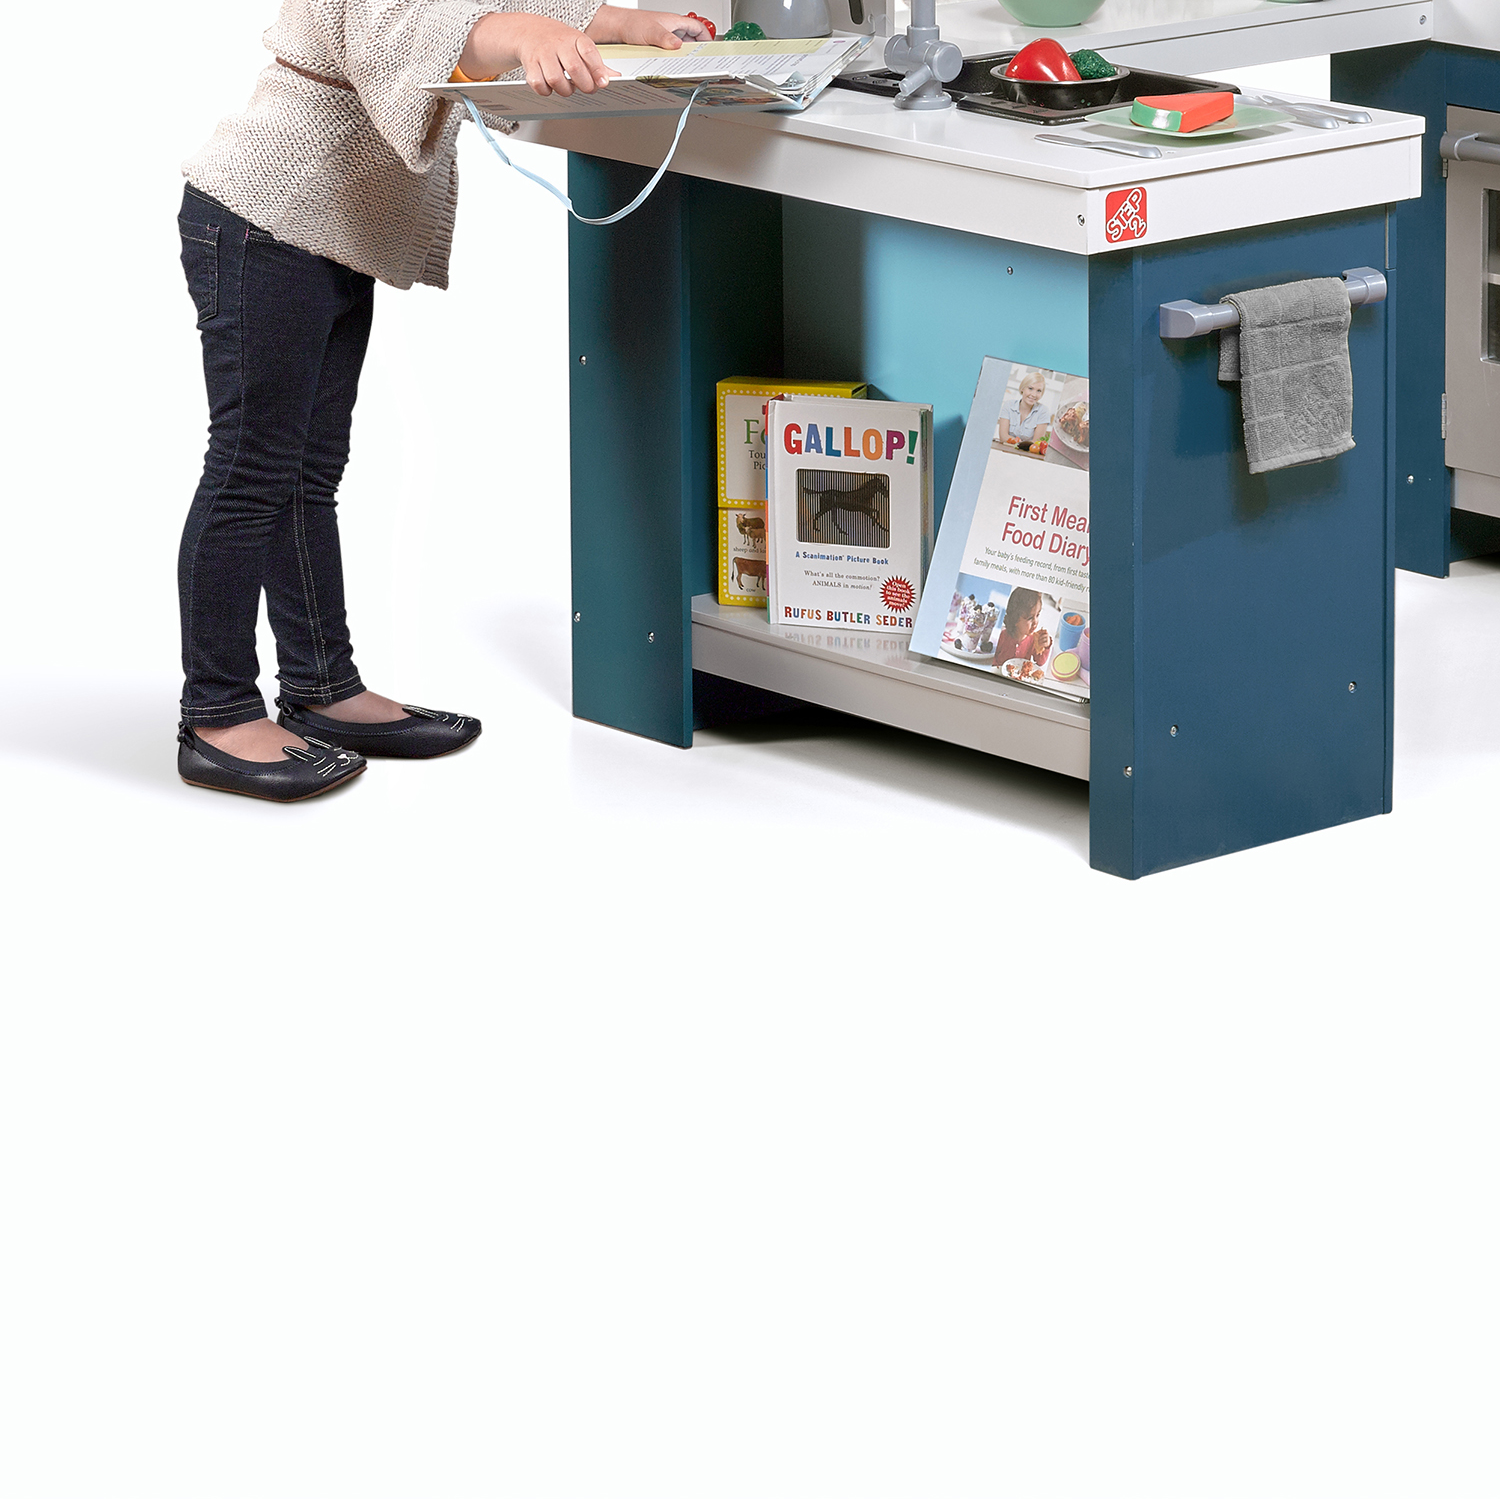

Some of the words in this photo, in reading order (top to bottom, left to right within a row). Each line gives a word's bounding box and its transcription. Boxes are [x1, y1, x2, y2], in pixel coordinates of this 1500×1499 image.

[1107, 188, 1142, 241] STEP
[1129, 215, 1147, 238] 2
[784, 422, 918, 464] GALLOP!
[1008, 495, 1048, 523] First
[1002, 522, 1046, 550] Food
[1049, 533, 1089, 566] Diary
[847, 555, 870, 564] Picture
[873, 557, 889, 565] Book
[985, 547, 996, 557] Your
[998, 550, 1014, 561] baby's
[1014, 554, 1034, 567] feeding
[1054, 563, 1066, 573] from
[1067, 567, 1078, 576] first
[804, 570, 825, 578] What's
[812, 580, 842, 588] ANIMALS
[1009, 566, 1020, 575] with
[1021, 570, 1035, 579] more
[1036, 573, 1047, 581] than
[1048, 575, 1055, 584] 80
[1056, 577, 1087, 592] kid-friendly
[784, 606, 822, 621] RUFUS
[826, 610, 871, 625] BUTLER
[876, 614, 913, 628] SEDER
